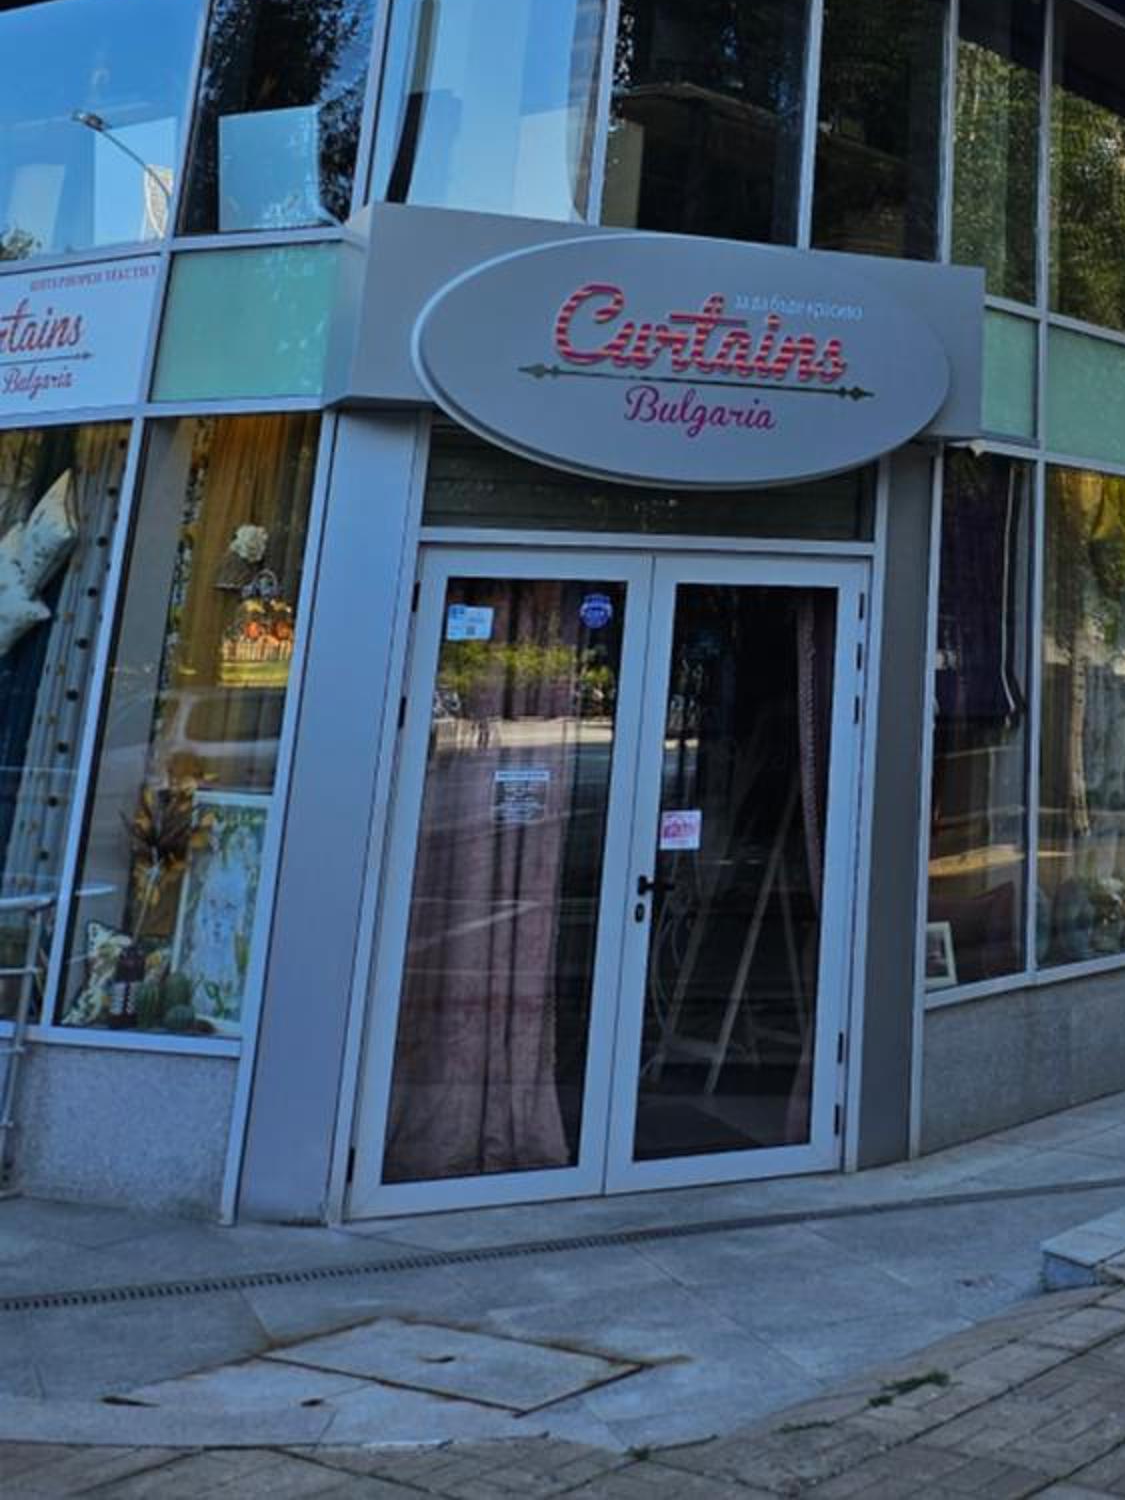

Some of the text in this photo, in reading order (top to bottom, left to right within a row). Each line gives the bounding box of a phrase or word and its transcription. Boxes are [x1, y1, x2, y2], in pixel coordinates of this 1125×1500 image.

[556, 283, 847, 383] Curtains
[2, 366, 73, 400] Bulgaria
[624, 386, 777, 437] Bulgaria
